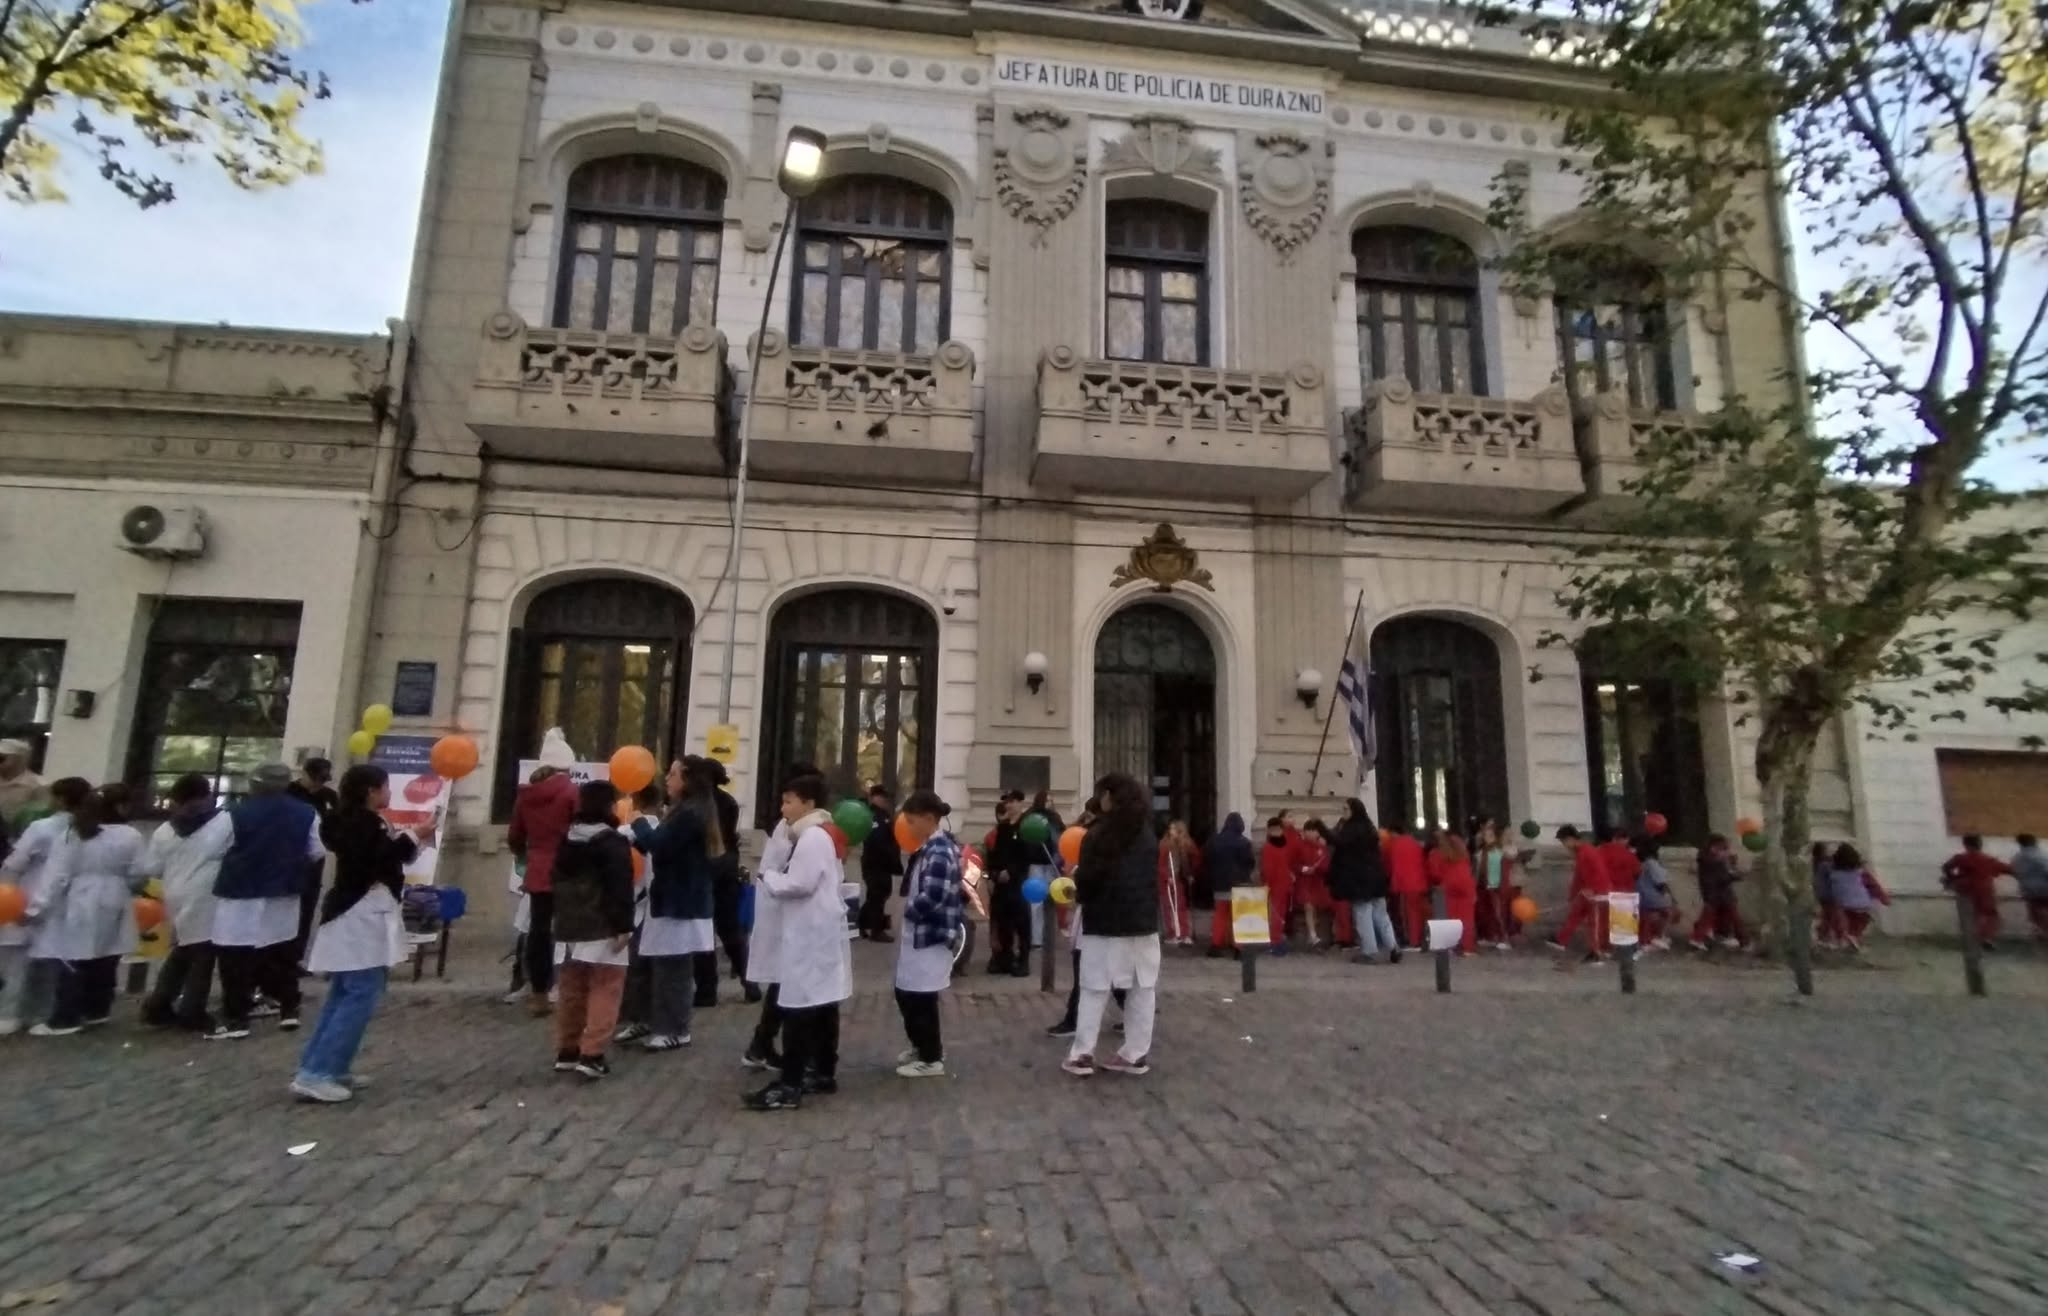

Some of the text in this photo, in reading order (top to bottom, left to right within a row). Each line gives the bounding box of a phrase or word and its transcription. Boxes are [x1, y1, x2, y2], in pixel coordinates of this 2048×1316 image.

[999, 60, 1323, 114] JEFATURA DE POLICIA DE DURAZNO
